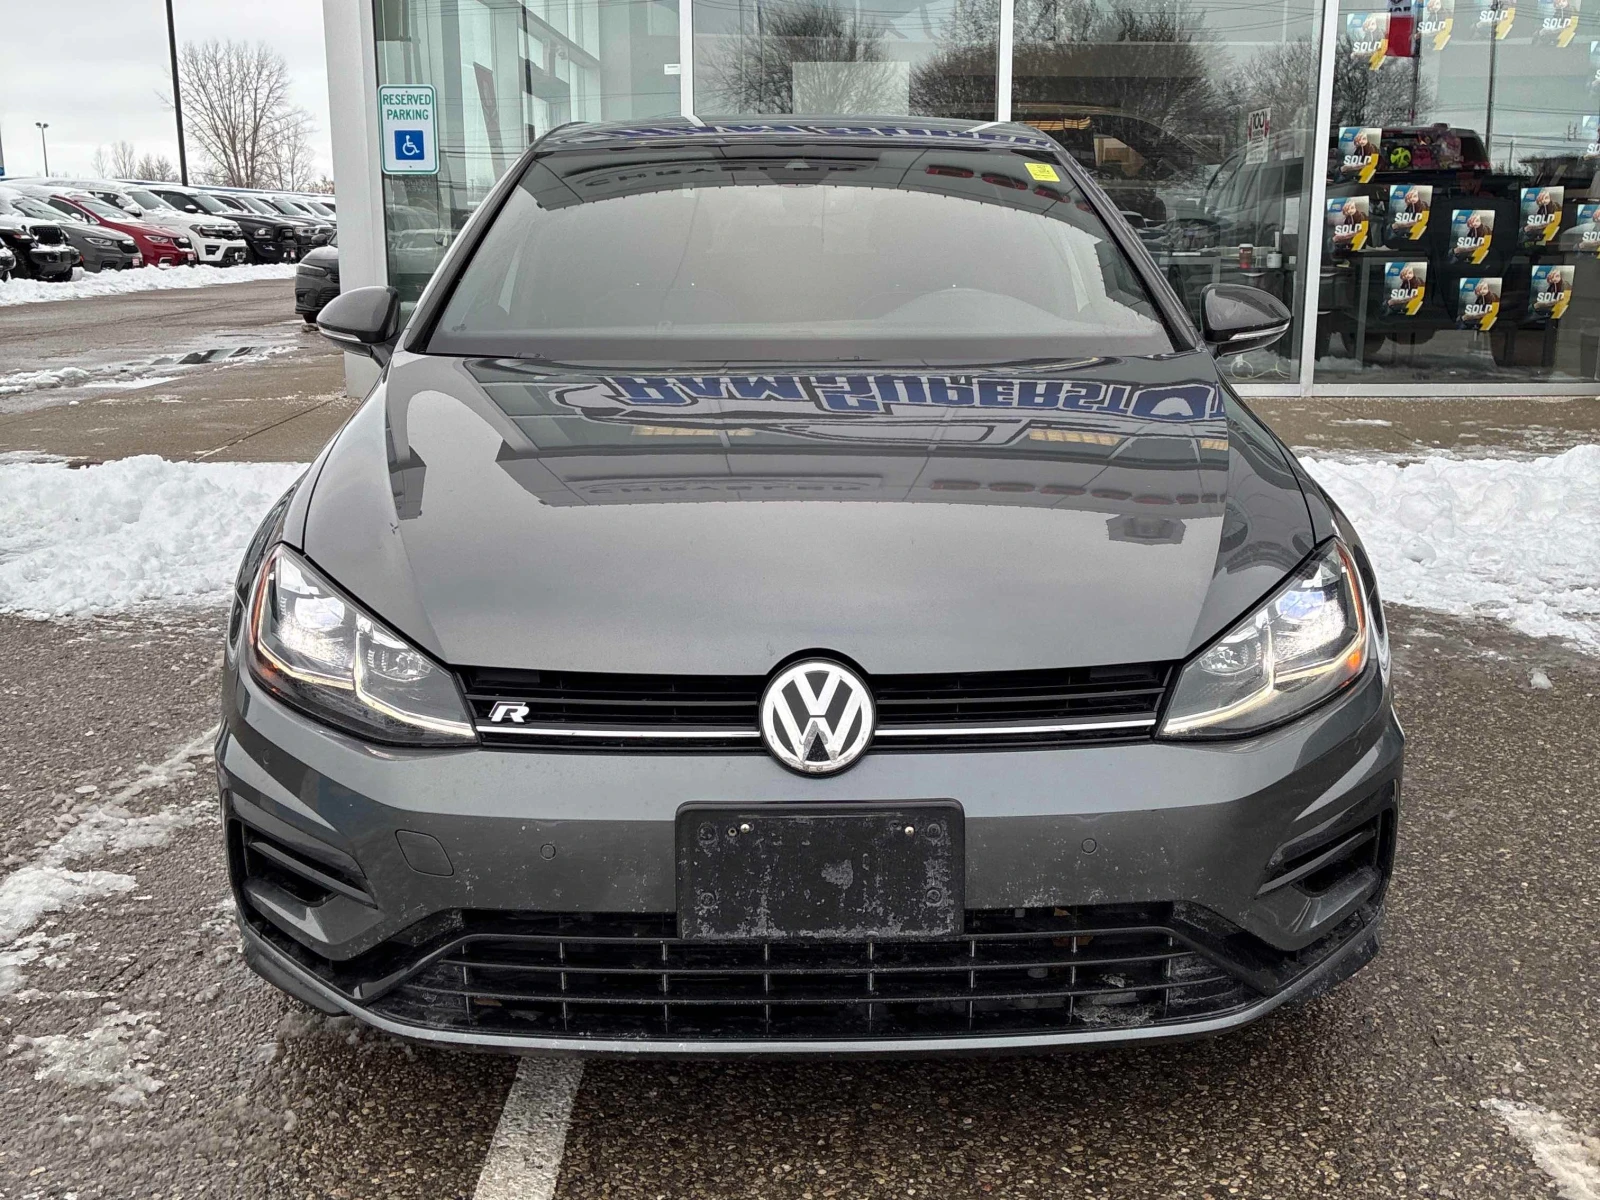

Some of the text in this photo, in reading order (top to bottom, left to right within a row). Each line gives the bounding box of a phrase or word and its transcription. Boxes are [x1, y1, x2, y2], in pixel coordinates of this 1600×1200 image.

[1480, 10, 1508, 21] SOLD
[1417, 21, 1446, 33] SOLD
[1542, 18, 1571, 29] SOLD
[1353, 41, 1381, 53] SOLD
[382, 94, 431, 106] RESERVED
[386, 109, 429, 121] PARKING
[1343, 154, 1371, 165] SOLD
[1394, 212, 1423, 223] SOLD
[1527, 213, 1555, 225] SOLD
[1334, 223, 1362, 235] SOLD
[1457, 236, 1485, 248] SOLD
[1390, 288, 1418, 299] SOLD
[1536, 291, 1564, 302] SOLD
[1464, 304, 1492, 315] SOLD
[489, 701, 529, 723] R
